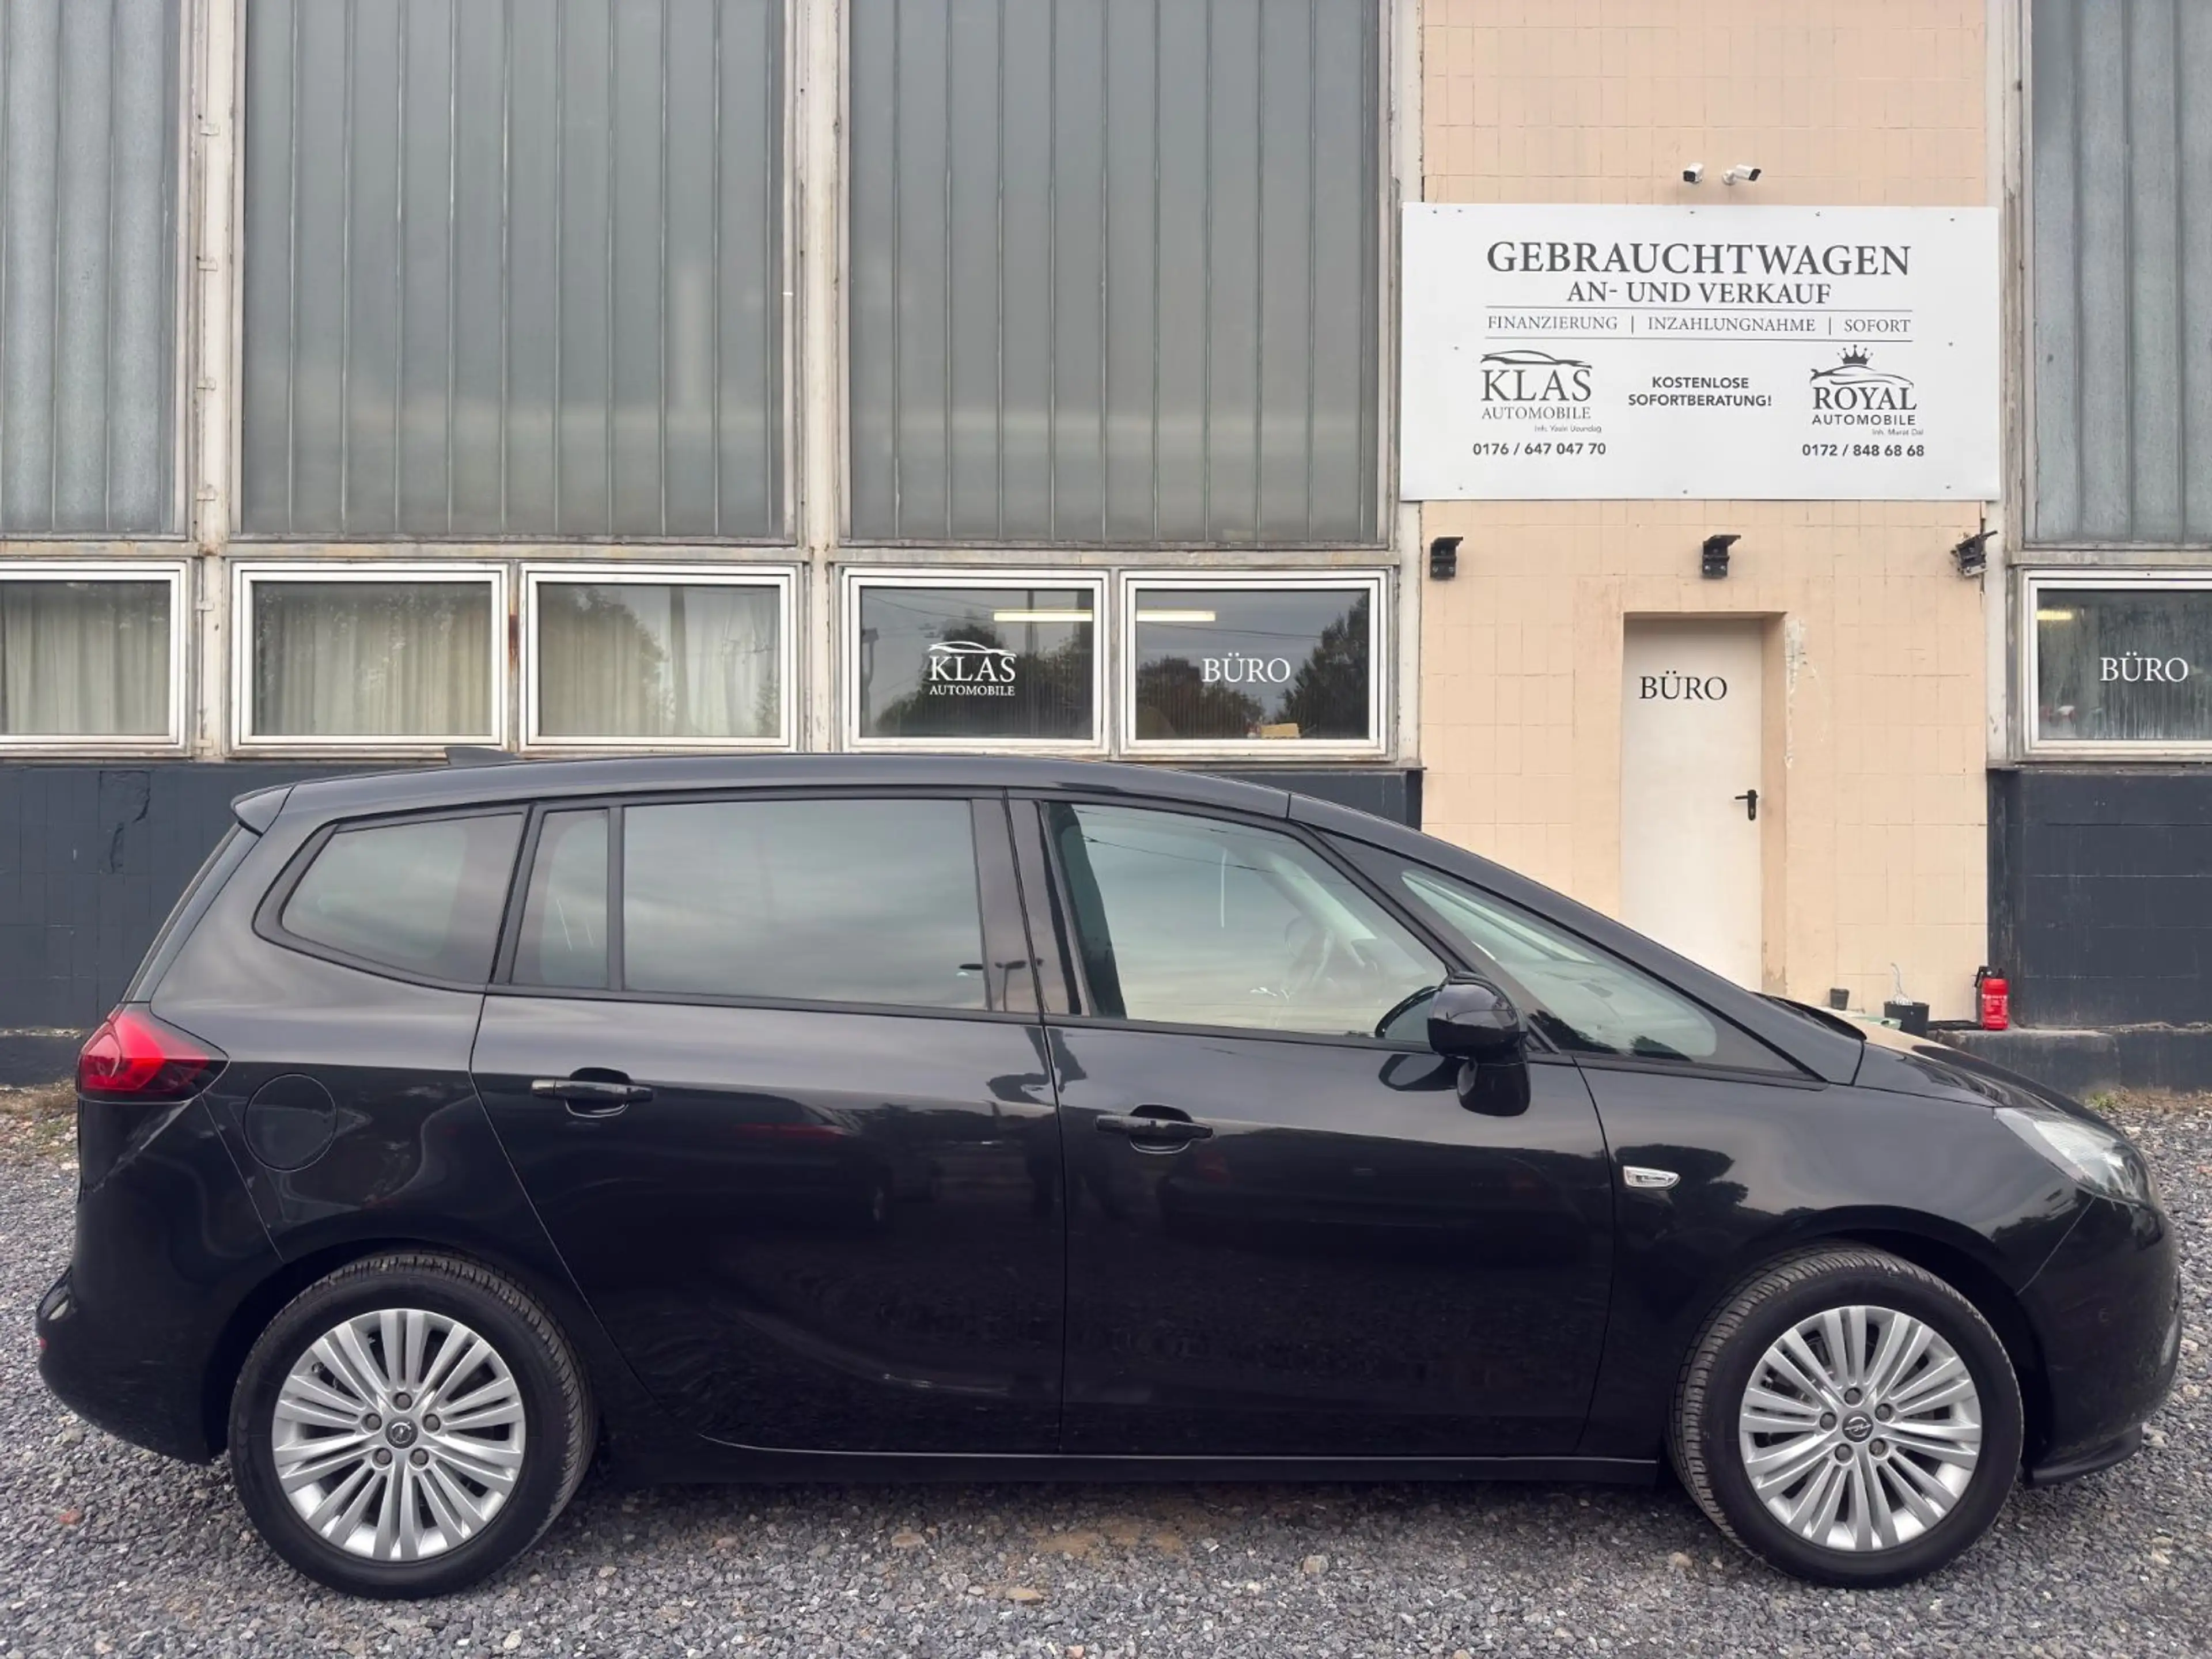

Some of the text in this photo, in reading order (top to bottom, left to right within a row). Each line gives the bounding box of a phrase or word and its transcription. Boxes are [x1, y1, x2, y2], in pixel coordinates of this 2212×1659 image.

[1487, 242, 1911, 275] GEBRAUCHTWAGEN
[1567, 282, 1831, 304] AN- UND VERKAUF
[1489, 316, 1911, 332] FINANZIERUNG INZAHLUNGNAHME SOFORT
[1482, 369, 1592, 402] KLAS
[1653, 377, 1749, 389] KOSTENLOSE
[1629, 394, 1771, 406] SOFORTBERATUNG!
[1813, 386, 1916, 410] ROYAL
[1482, 407, 1590, 419] AUTOMOBILE
[1812, 414, 1915, 425] AUTOMOBILE
[1473, 442, 1605, 455] 0176 / 647 047 70
[1802, 444, 1924, 457] 0172 / 848 68 68
[929, 656, 1016, 683] KLAS
[1203, 653, 1290, 682] BÜRO
[2100, 652, 2188, 682] BÜRO
[929, 685, 1015, 696] AUTOMOBILE
[1639, 671, 1727, 700] BÜRO
